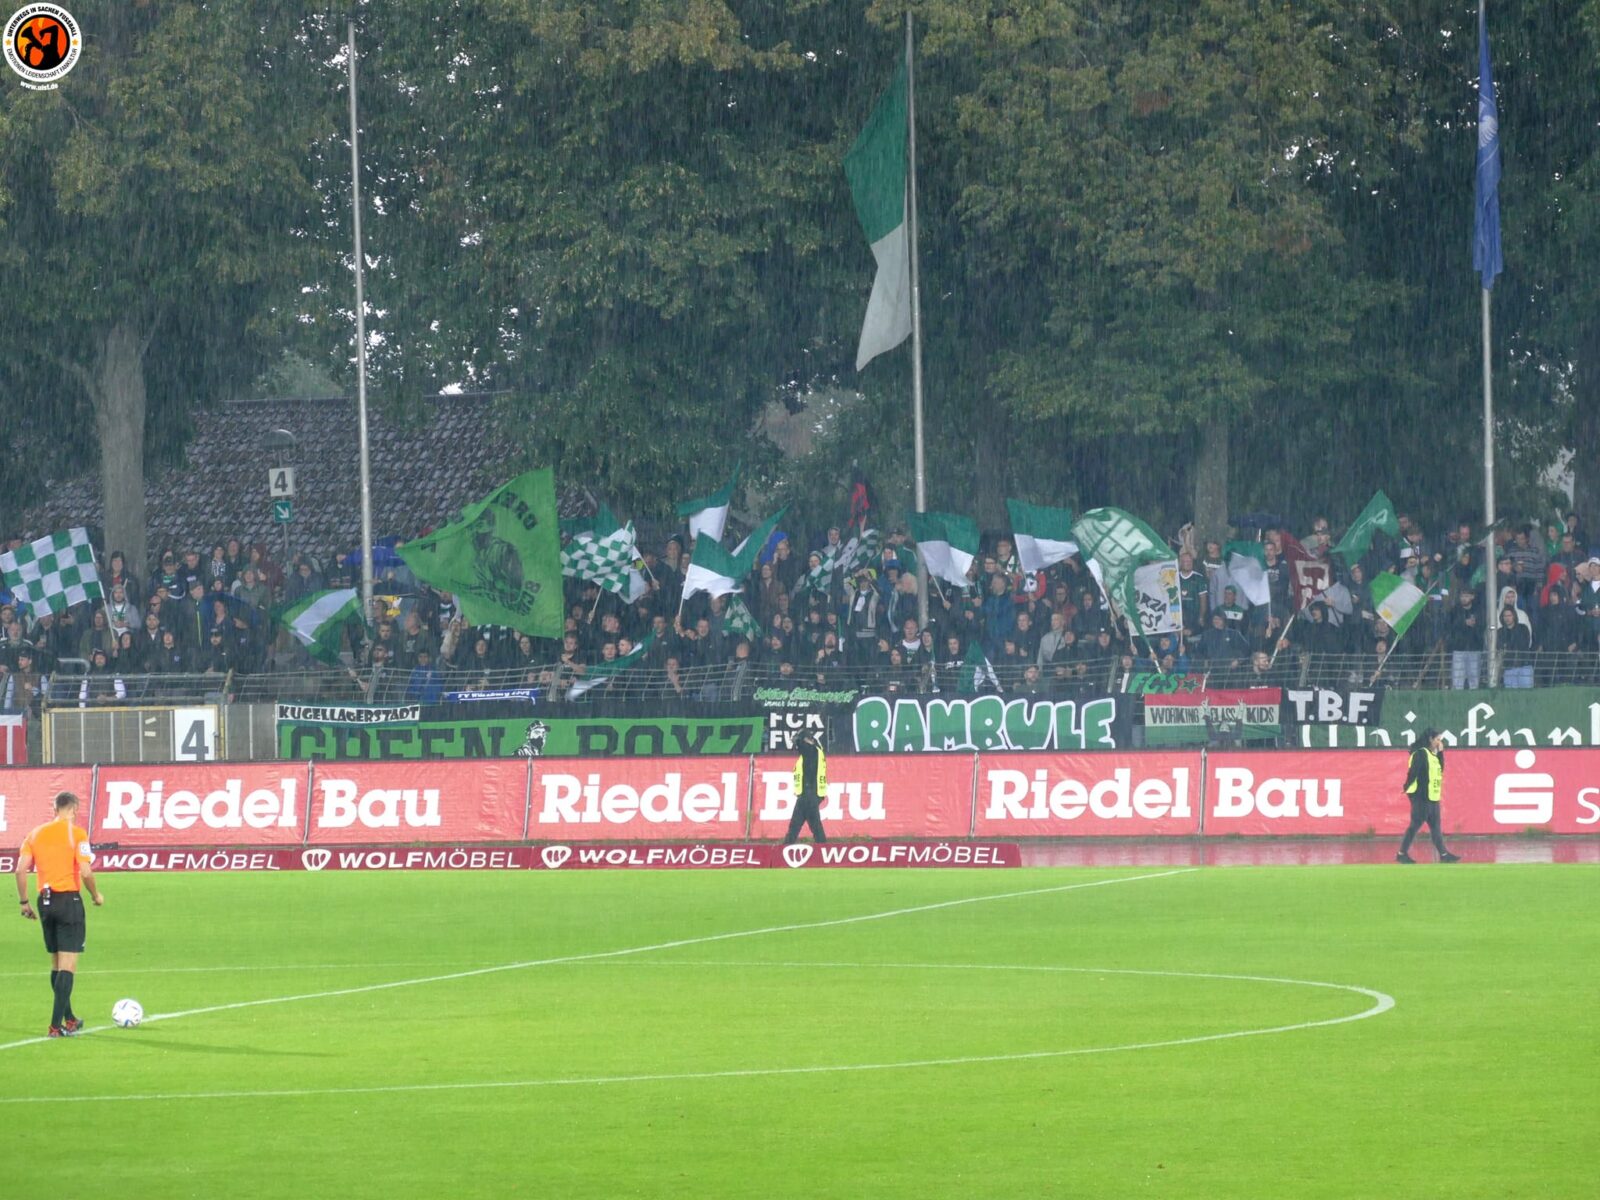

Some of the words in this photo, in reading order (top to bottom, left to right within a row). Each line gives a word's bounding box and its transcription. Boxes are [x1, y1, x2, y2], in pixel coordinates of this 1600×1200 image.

[274, 470, 288, 493] 4
[279, 705, 419, 722] KUGELLAGERSTADT
[1150, 707, 1199, 723] WORKING
[1246, 706, 1275, 723] KIDS
[1287, 689, 1375, 723] T.B.F.
[769, 712, 824, 728] FCK
[852, 695, 1116, 752] BAMBULE
[180, 719, 209, 760] 4
[103, 778, 297, 829] Riedel
[318, 779, 441, 828] Bau
[539, 772, 739, 824] Riedel
[985, 767, 1191, 820] Riedel
[1213, 767, 1344, 818] Bau
[102, 851, 280, 870] WOLFMÖBEL
[339, 848, 521, 869] WOLFMÖBEL
[579, 844, 761, 866] WOLFMÖBEL
[820, 843, 1006, 864] WOLFMÖBEL
